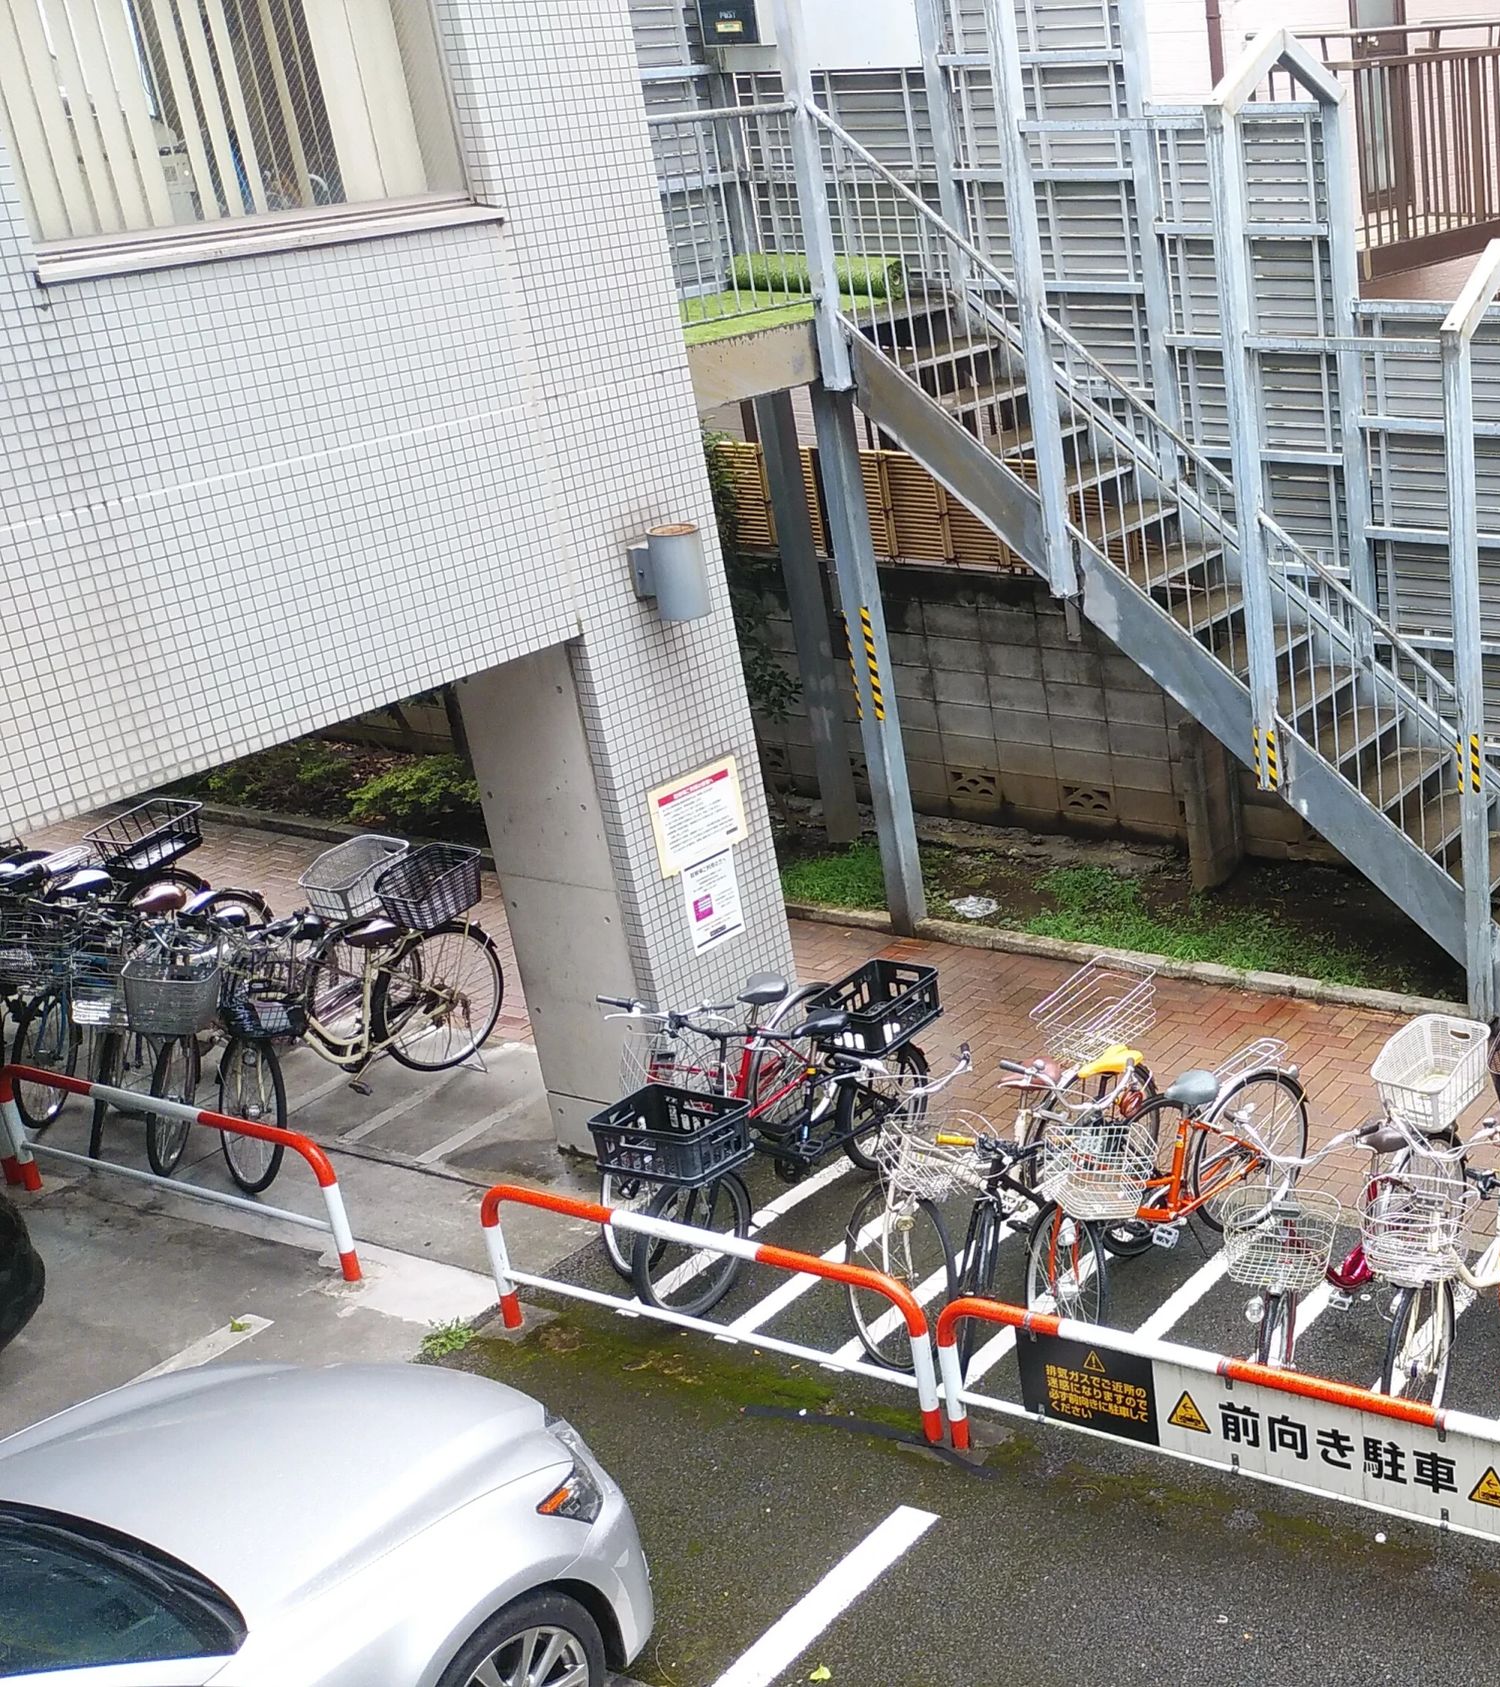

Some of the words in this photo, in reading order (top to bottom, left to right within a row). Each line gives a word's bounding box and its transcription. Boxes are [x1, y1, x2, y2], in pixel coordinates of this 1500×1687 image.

[1045, 1364, 1147, 1399] 排気ガスでご近所の
[1046, 1376, 1148, 1410] 迷惑になりますので
[1048, 1388, 1149, 1423] 必ず前向きに駐車して
[1051, 1400, 1093, 1419] ください
[1218, 1401, 1459, 1495] 前向き駐車
